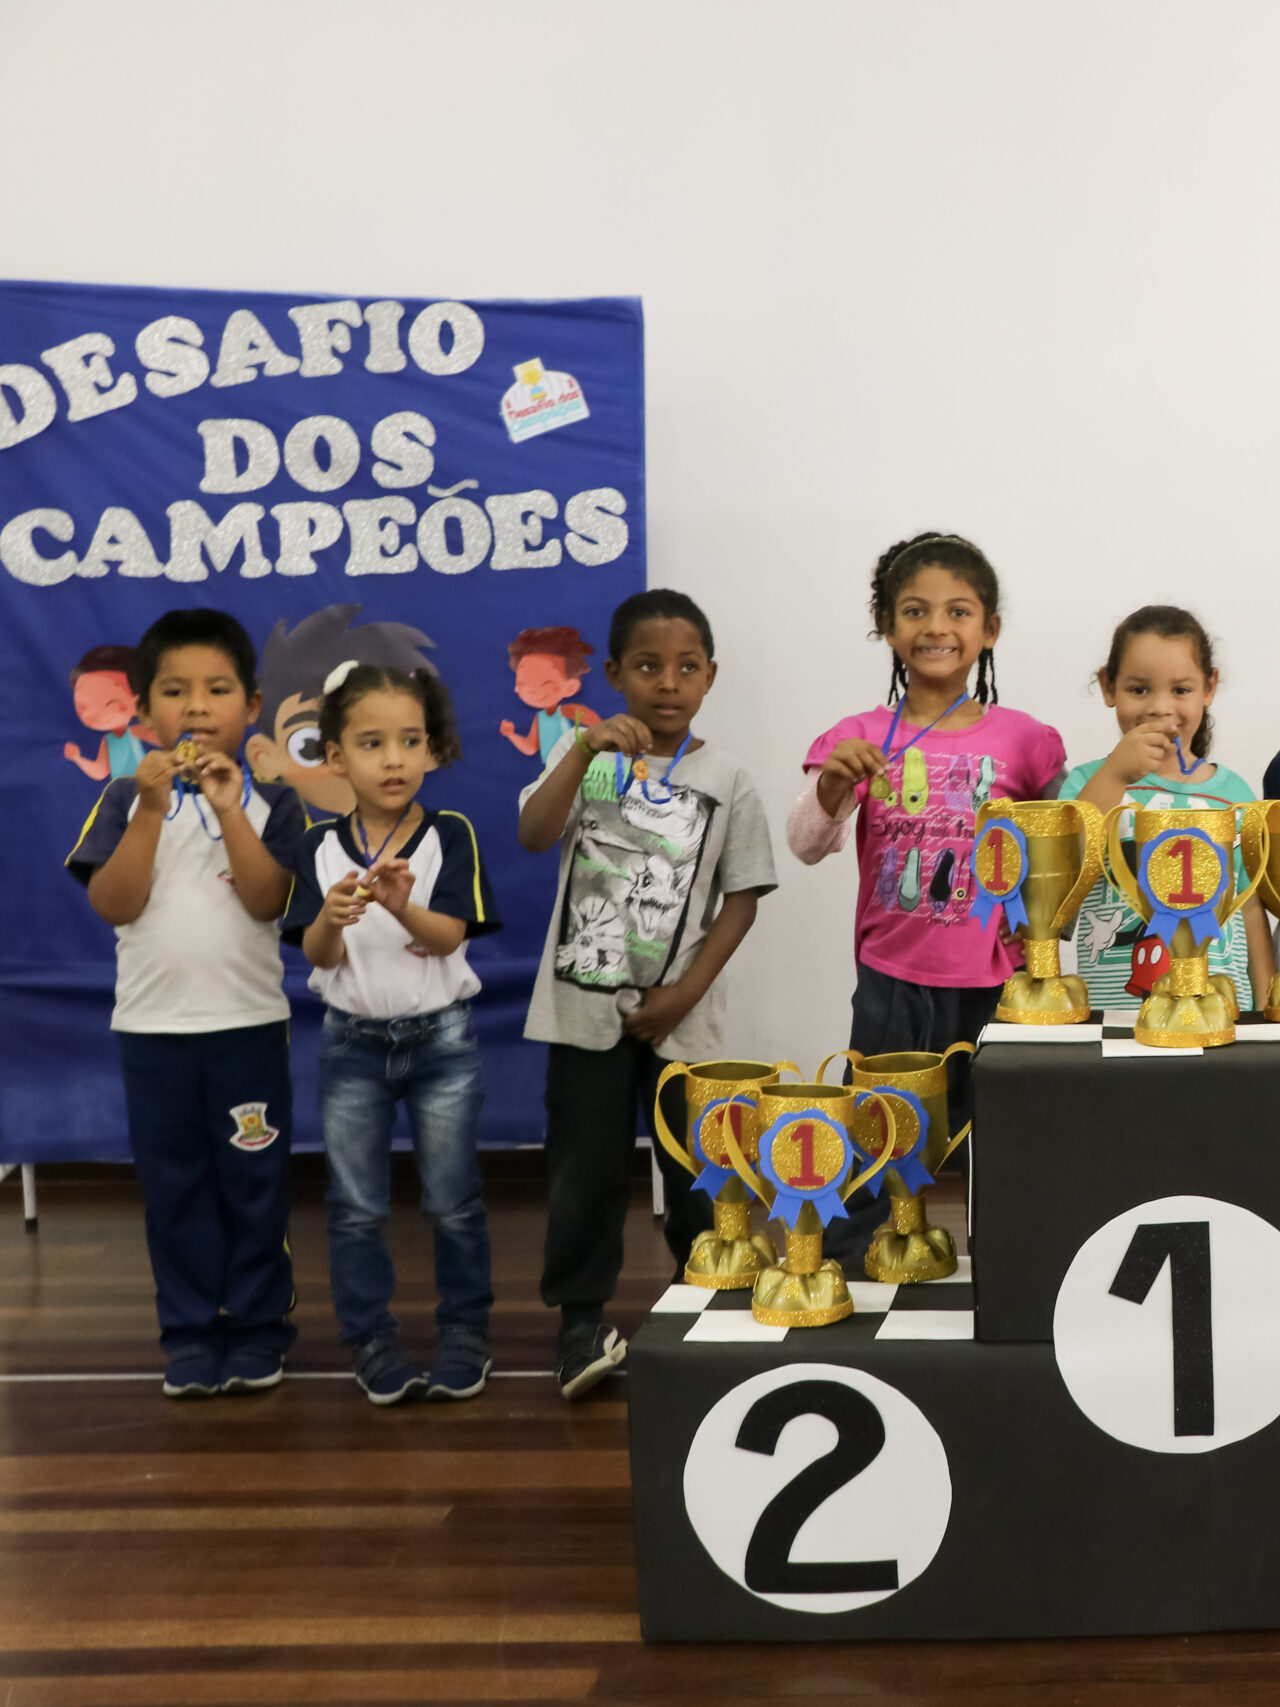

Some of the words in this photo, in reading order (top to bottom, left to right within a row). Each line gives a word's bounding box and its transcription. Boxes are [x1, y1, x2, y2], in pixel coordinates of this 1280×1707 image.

[0, 300, 485, 449] DESAFIO
[197, 411, 436, 494] DOS
[0, 479, 629, 586] CAMPEÕES
[985, 828, 1008, 891] 1
[1167, 839, 1205, 904] 1
[716, 1103, 751, 1166] 1
[788, 1123, 825, 1187] 1
[869, 1099, 905, 1158] 1
[1108, 1220, 1215, 1437] 1
[734, 1379, 900, 1595] 2
